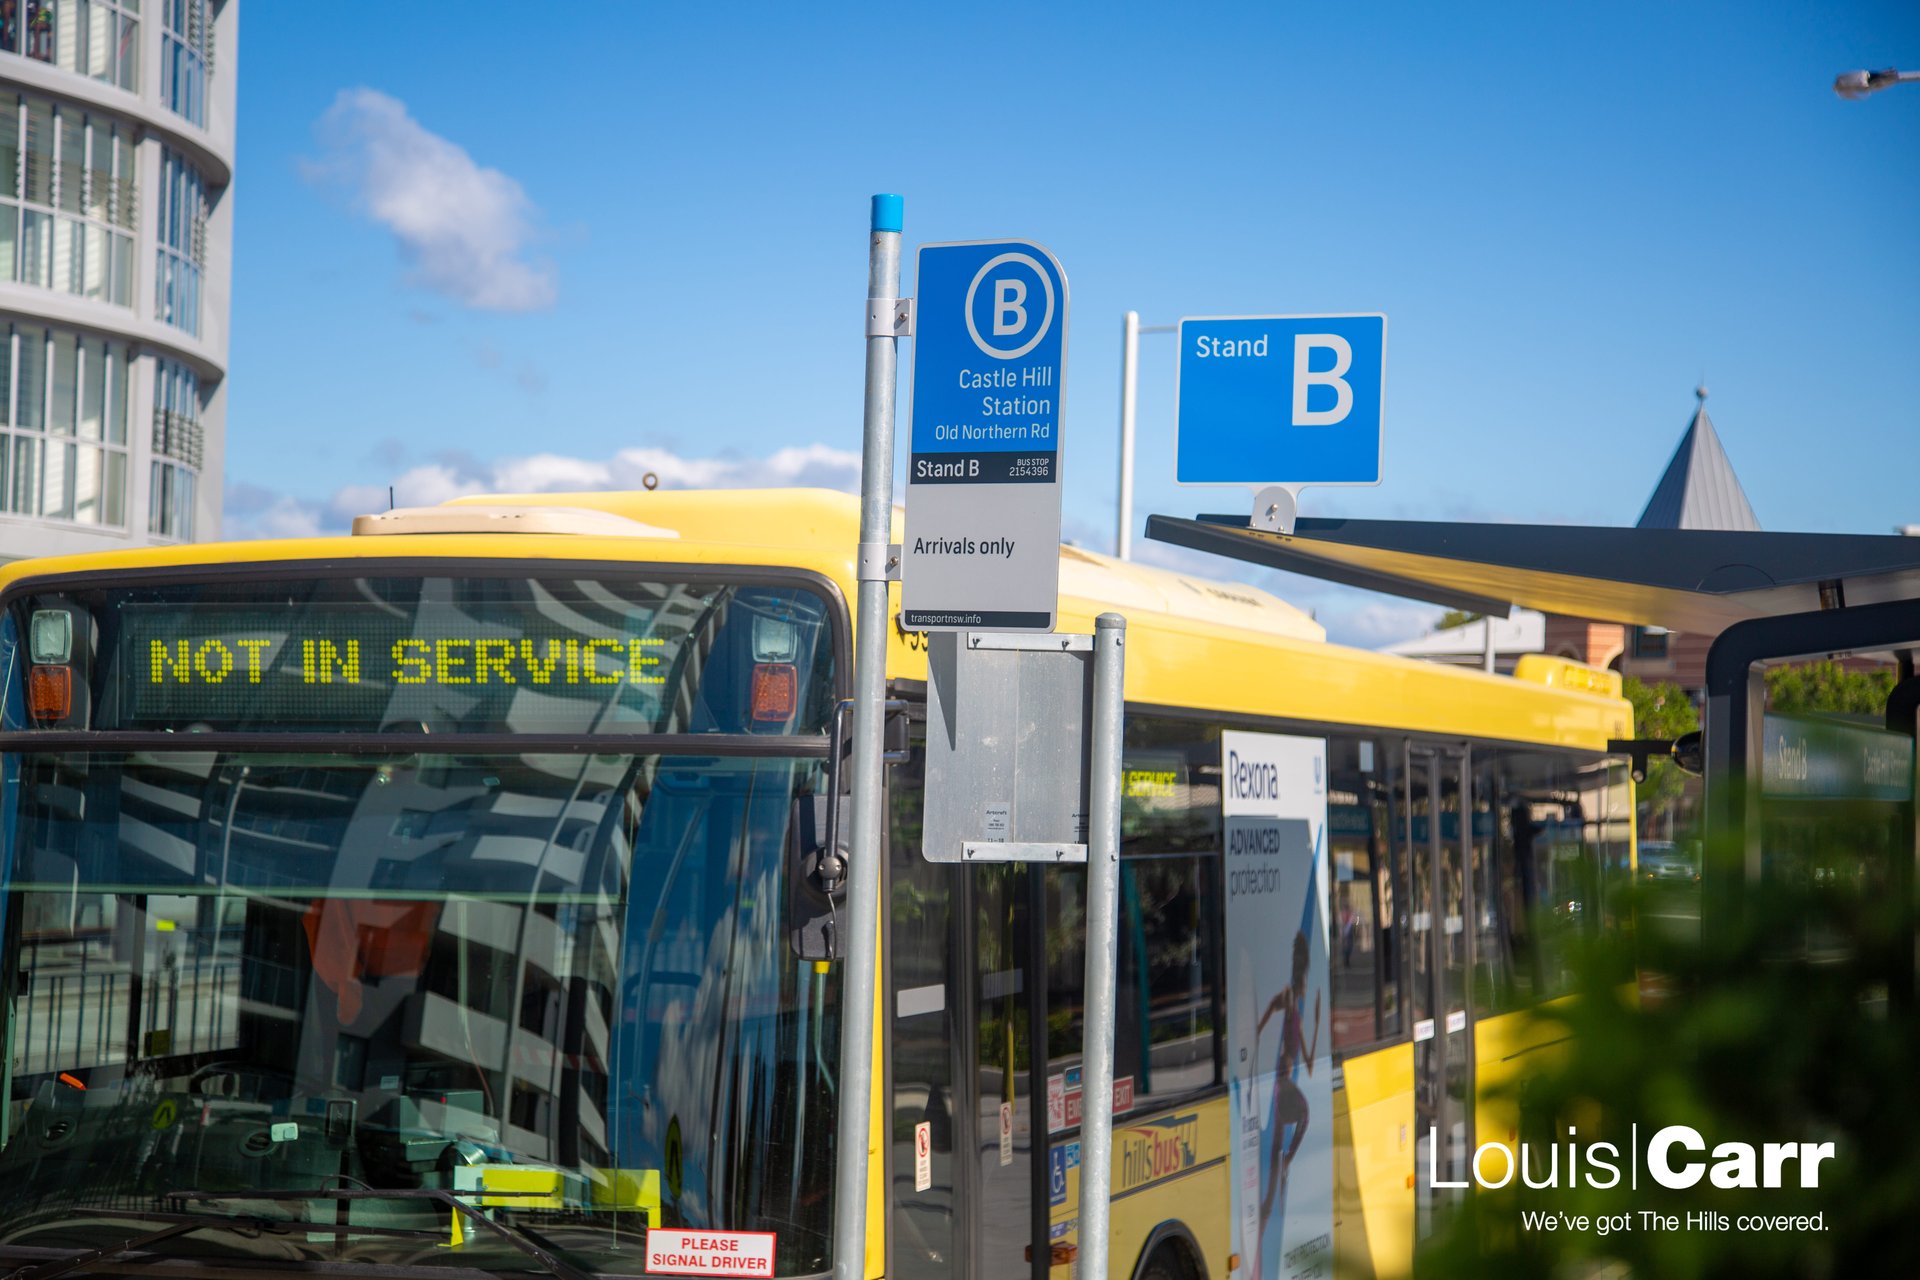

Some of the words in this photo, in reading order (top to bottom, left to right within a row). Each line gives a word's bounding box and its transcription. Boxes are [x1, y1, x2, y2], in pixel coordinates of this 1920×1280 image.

[993, 279, 1027, 336] B
[959, 368, 1017, 389] Castle
[1022, 366, 1052, 387] Hill
[1196, 334, 1268, 358] Stand
[1292, 333, 1354, 426] B
[982, 395, 1050, 416] Station
[935, 425, 958, 441] Old
[962, 424, 1027, 440] Northern
[1031, 423, 1050, 438] Rd
[917, 459, 965, 478] Stand
[969, 459, 980, 477] B
[1009, 466, 1050, 477] 2154396
[1017, 458, 1031, 466] BUS
[1031, 458, 1050, 466] STOP
[913, 537, 975, 555] Arrivals
[979, 537, 1015, 559] only
[911, 614, 981, 625] transportnsw.info
[150, 639, 270, 684] NOT
[303, 639, 360, 684] IN
[391, 638, 666, 685] SERVICE
[1229, 749, 1278, 799] Rexona
[1230, 828, 1281, 856] ADVANCED
[1230, 862, 1281, 901] protection
[1115, 1085, 1131, 1108] EXIT
[681, 1237, 739, 1252] PLEASE
[652, 1253, 707, 1267] SIGNAL
[711, 1255, 767, 1270] DRIVER
